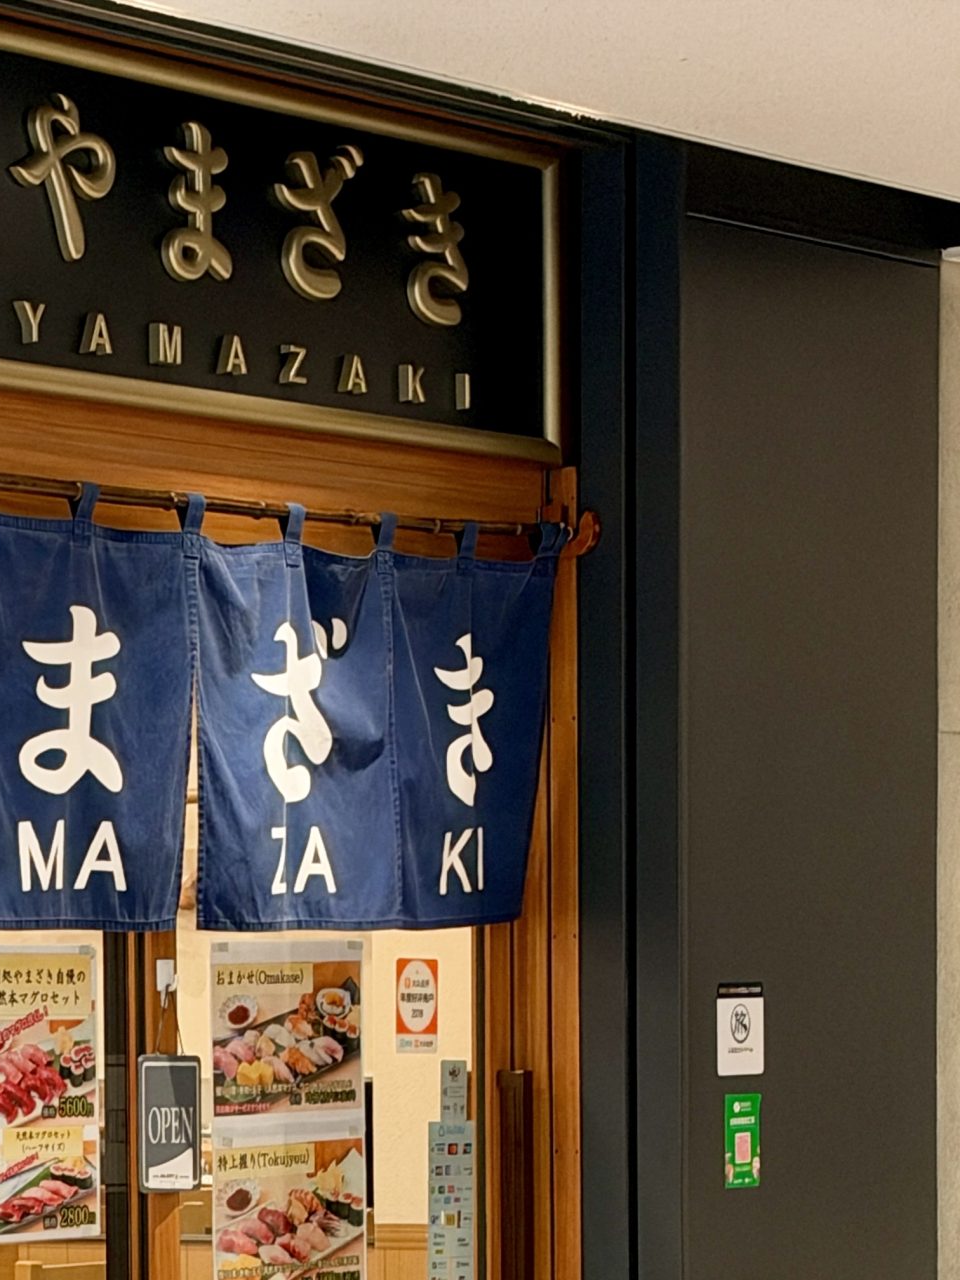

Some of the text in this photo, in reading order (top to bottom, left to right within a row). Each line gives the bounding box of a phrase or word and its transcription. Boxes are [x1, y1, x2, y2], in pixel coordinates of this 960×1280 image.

[8, 92, 470, 326] やまざき
[13, 299, 471, 411] YAMAZAKI
[18, 819, 127, 893] MA
[269, 823, 338, 896] ZA
[439, 826, 485, 896] KI
[147, 1105, 194, 1145] OPEN
